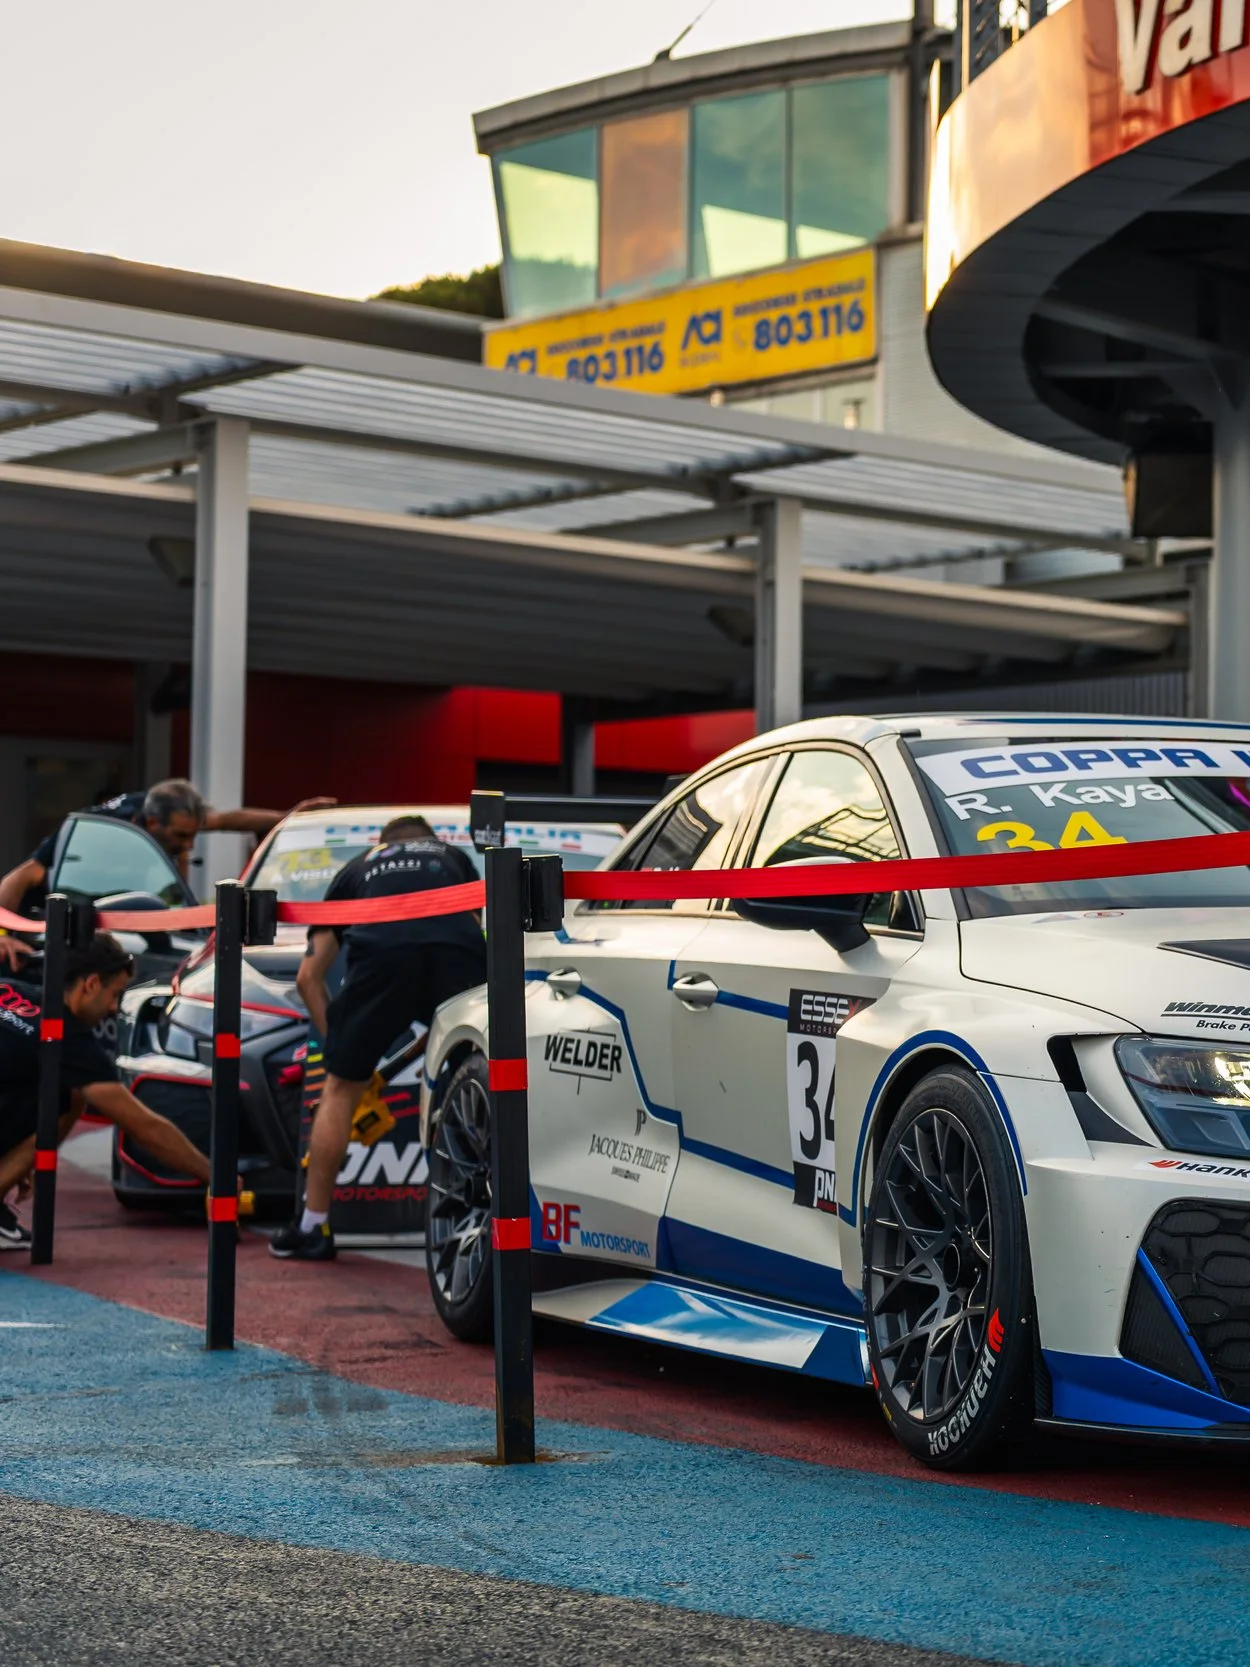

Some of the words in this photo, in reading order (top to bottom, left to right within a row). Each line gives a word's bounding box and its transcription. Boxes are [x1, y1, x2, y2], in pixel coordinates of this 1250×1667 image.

[960, 748, 1222, 780] COPPA
[947, 792, 1014, 821] R.
[1028, 782, 1176, 809] Kaya
[799, 1023, 838, 1035] MOTORSP
[1196, 1019, 1237, 1031] Brake
[544, 1033, 622, 1074] WELDER
[588, 1133, 635, 1163] JACQUES
[632, 1145, 671, 1174] PHILIPPE
[813, 1169, 836, 1207] PN
[541, 1202, 581, 1245] BF
[580, 1229, 651, 1258] MOTORSPORT
